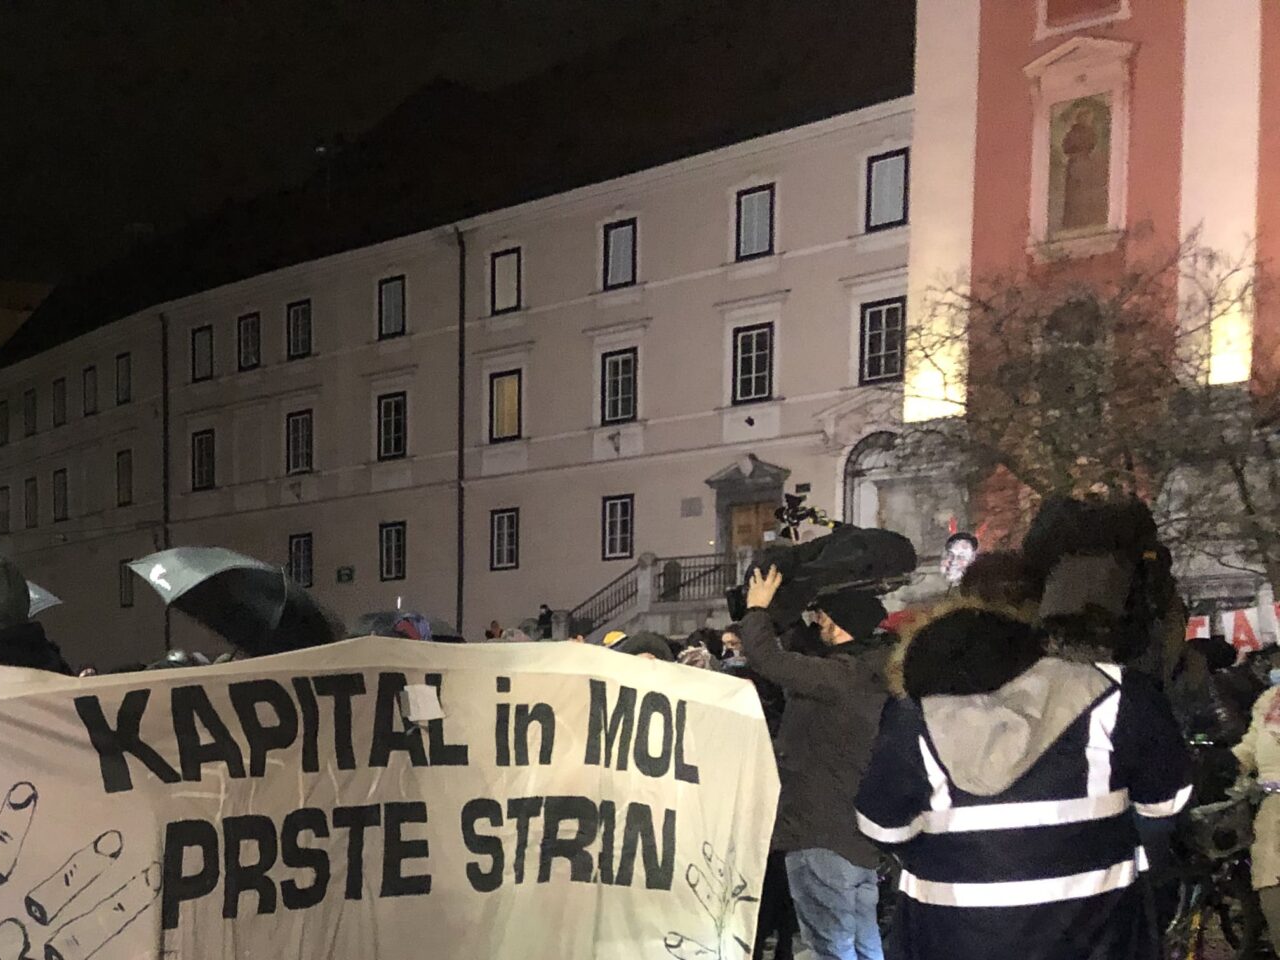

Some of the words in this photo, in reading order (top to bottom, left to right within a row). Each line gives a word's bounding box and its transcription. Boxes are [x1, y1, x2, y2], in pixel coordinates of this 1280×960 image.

[73, 671, 469, 794] KAPITAL
[494, 675, 556, 767] in
[583, 678, 700, 785] MOL
[162, 800, 433, 930] PRSTE
